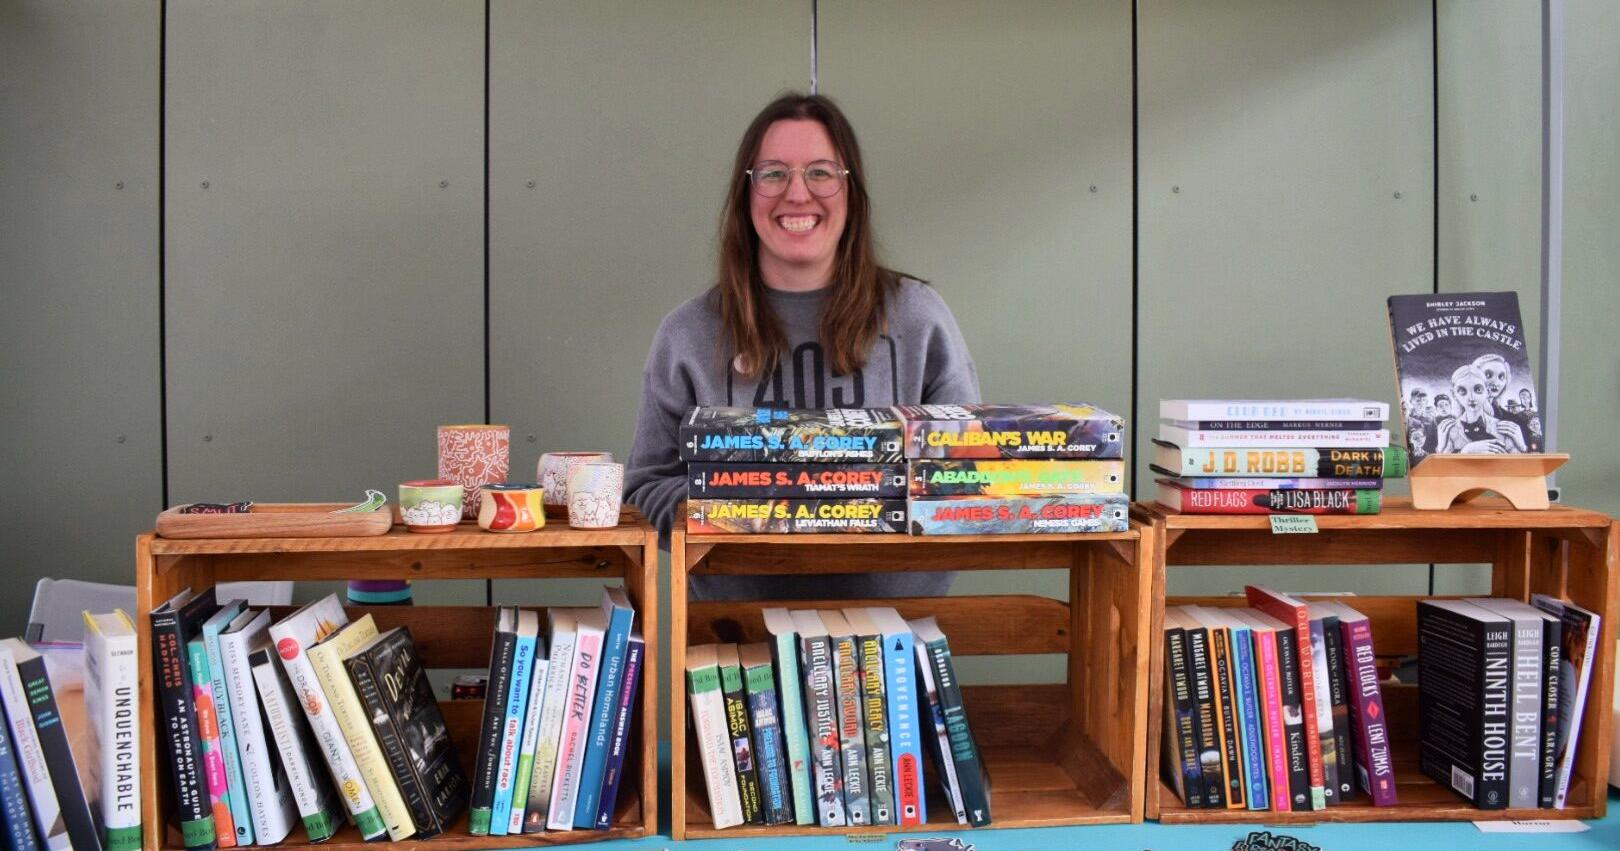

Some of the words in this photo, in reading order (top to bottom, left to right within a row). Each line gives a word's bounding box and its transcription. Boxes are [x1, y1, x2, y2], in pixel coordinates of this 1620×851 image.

[1406, 323, 1426, 336] WE
[1428, 315, 1461, 330] HAVE
[1465, 315, 1516, 334] ALWAYS
[1402, 332, 1434, 353] LIVED
[1436, 328, 1448, 338] IN
[1450, 327, 1474, 336] THE
[1476, 328, 1522, 350] CASTLE
[701, 435, 763, 450] JAMES
[768, 436, 785, 450] S.
[789, 436, 807, 450] A.
[813, 436, 878, 450] COREY
[927, 431, 1022, 446] CALIBAN'S
[1026, 431, 1067, 445] WAR
[1017, 444, 1046, 452] JAMES
[1047, 444, 1054, 452] S.
[1067, 444, 1097, 452] COREY
[1202, 451, 1218, 473] J.
[1223, 451, 1240, 473] D.
[1247, 451, 1306, 473] ROBB
[1331, 451, 1368, 461] DARK
[709, 472, 772, 486] JAMES
[776, 472, 792, 486] S.
[797, 472, 816, 486] A.
[820, 471, 884, 485] COREY
[1335, 465, 1381, 476] DEATH
[804, 483, 846, 491] TIAMAT'S
[847, 483, 879, 491] WRATH
[1191, 491, 1211, 507] RED
[1213, 492, 1247, 508] FLAGS
[1287, 492, 1311, 508] LISA
[1313, 492, 1349, 508] BLACK
[708, 505, 770, 519] JAMES
[774, 505, 791, 519] S.
[795, 505, 814, 519] A.
[819, 505, 883, 519] COREY
[932, 505, 993, 521] JAMES
[998, 505, 1014, 520] S.
[1019, 505, 1036, 520] A.
[1042, 504, 1104, 519] COREY
[1274, 524, 1313, 532] Mystery
[1486, 631, 1508, 641] LEIGH
[1518, 629, 1540, 638] LEIGH
[158, 634, 174, 688] HADFIELD
[226, 640, 238, 664] MISS
[518, 644, 528, 657] So
[578, 652, 592, 669] DO
[629, 648, 638, 662] THE
[1169, 633, 1184, 671] MARGARET
[1192, 633, 1205, 670] MARGARET
[1281, 636, 1291, 664] OCTAVIA
[1328, 646, 1338, 671] BOOK
[1355, 644, 1371, 663] RED
[1549, 645, 1559, 669] COME
[169, 657, 183, 686] CHRIS
[514, 658, 525, 678] you
[605, 655, 620, 688] Urban
[809, 641, 828, 697] ANCILLARY
[837, 640, 856, 697] ANCILLARY
[862, 639, 881, 695] ANCILLARY
[1217, 659, 1227, 693] OCTAVIA
[1241, 662, 1250, 689] OCTAVIA
[1265, 663, 1275, 698] OCTAVIA
[1357, 664, 1377, 697] CLOCKS
[1514, 655, 1540, 704] HELL
[211, 678, 225, 702] BUY
[229, 664, 247, 708] MEMORY
[512, 678, 523, 702] want
[1174, 672, 1188, 700] ATWOOD
[1195, 671, 1208, 699] ATWOOD
[1284, 671, 1294, 695] BUTLER
[1331, 678, 1341, 704] FLORA
[1483, 656, 1508, 716] NINTH
[1546, 675, 1558, 709] CLOSER
[176, 698, 185, 713] AN
[510, 703, 519, 714] to
[570, 673, 589, 721] BETTER
[894, 657, 910, 748] PROVENANCE
[1244, 697, 1253, 719] BUTLER
[169, 715, 179, 729] TO
[215, 702, 231, 739] BLACK
[238, 709, 251, 736] LANE
[507, 719, 517, 737] talk
[595, 688, 614, 747] Homelands
[615, 706, 627, 736] ANSWER
[726, 696, 740, 737] ASIMOV
[734, 699, 746, 732] ISAAC
[815, 698, 832, 737] JUSTICE
[841, 698, 858, 737] SWORD
[866, 697, 884, 732] MERCY
[1180, 715, 1193, 734] ORYX
[1222, 705, 1232, 732] BUTLER
[1270, 710, 1279, 737] BUTLER
[172, 733, 183, 755] LIFE
[566, 731, 577, 762] RACHEL
[612, 736, 621, 756] BOOK
[943, 705, 973, 762] LAGOON
[1247, 723, 1258, 762] ADULTHOOD
[1367, 722, 1384, 745] LENI
[1513, 710, 1538, 760] BENT
[1545, 731, 1554, 753] SARA
[114, 686, 133, 812] UNQUENCHABLE
[177, 716, 197, 786] ASTRONAUT'S
[320, 731, 341, 764] GIANT
[502, 738, 515, 766] about
[821, 748, 834, 766] ANN
[846, 748, 859, 766] ANN
[872, 746, 884, 765] ANN
[1184, 748, 1198, 771] CRAKE
[1226, 739, 1235, 761] DAWN
[1273, 744, 1282, 772] IMAGO
[1288, 731, 1304, 772] Kindred
[1370, 745, 1389, 776] ZUMAS
[1481, 721, 1506, 782] HOUSE
[175, 757, 185, 771] ON
[499, 767, 509, 788] race
[902, 757, 911, 773] ANN
[1251, 763, 1260, 779] RITES
[1543, 755, 1554, 779] GRAN
[177, 773, 191, 806] EARTH
[560, 764, 572, 801] RICKETTS
[821, 767, 836, 794] LECKIE
[848, 767, 861, 794] LECKIE
[873, 765, 886, 792] LECKIE
[903, 773, 913, 799] LECKIE
[189, 789, 202, 820] GUIDE
[739, 774, 752, 822] FOUNDATION
[747, 780, 758, 812] SECOND
[14, 792, 26, 818] LOVE
[22, 821, 33, 847] HAVE
